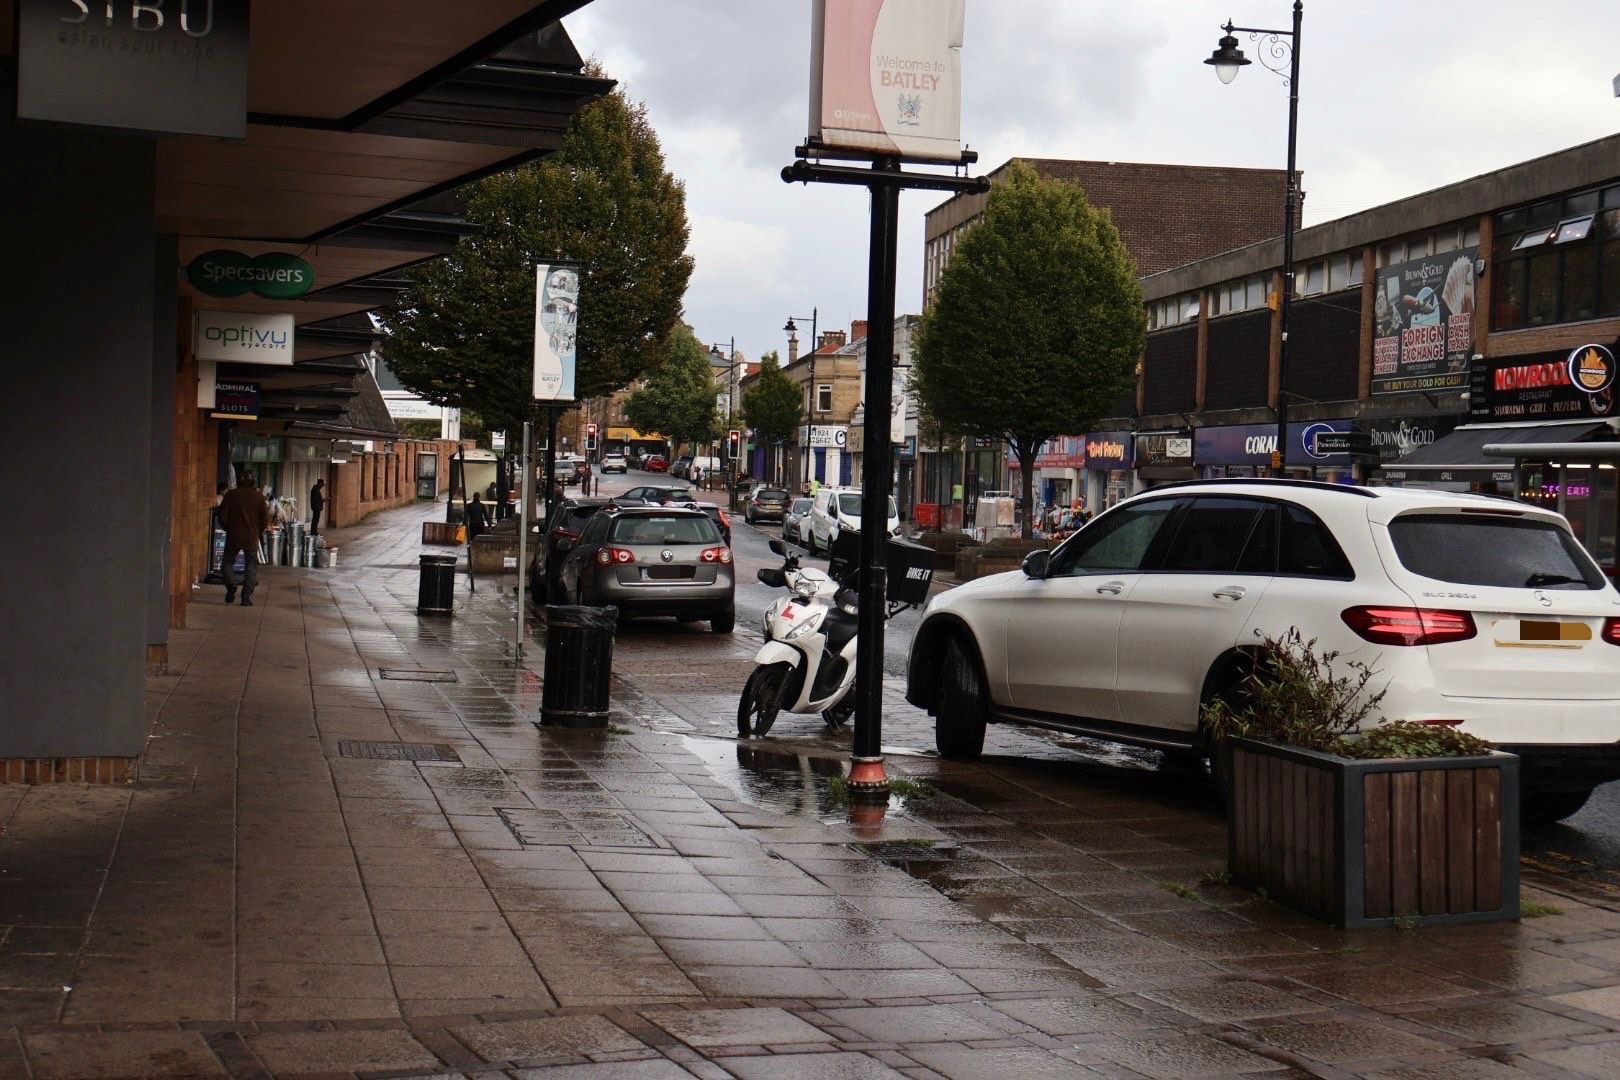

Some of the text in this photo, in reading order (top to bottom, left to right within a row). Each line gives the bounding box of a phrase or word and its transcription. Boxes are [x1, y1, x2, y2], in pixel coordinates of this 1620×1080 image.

[876, 54, 945, 73] Welcome to
[881, 70, 940, 91] BATLEY
[203, 261, 303, 283] Specsavers
[206, 326, 287, 348] optivu
[1402, 325, 1444, 348] FOREIGN
[1448, 324, 1469, 340] CASH
[241, 342, 286, 350] eyecare
[1402, 343, 1445, 363] EXCHANGE
[216, 383, 257, 393] ADMIRAL
[1384, 375, 1461, 390] WE BUY YOUR GOLD FOR CASH
[1520, 390, 1553, 401] RESTAURANT
[221, 403, 249, 412] SLOTS
[1529, 402, 1547, 413] GRILL
[1553, 400, 1581, 412] PIZZERIA
[1246, 436, 1277, 454] CORAL
[906, 566, 931, 581] BIKE IT
[781, 605, 795, 620] L
